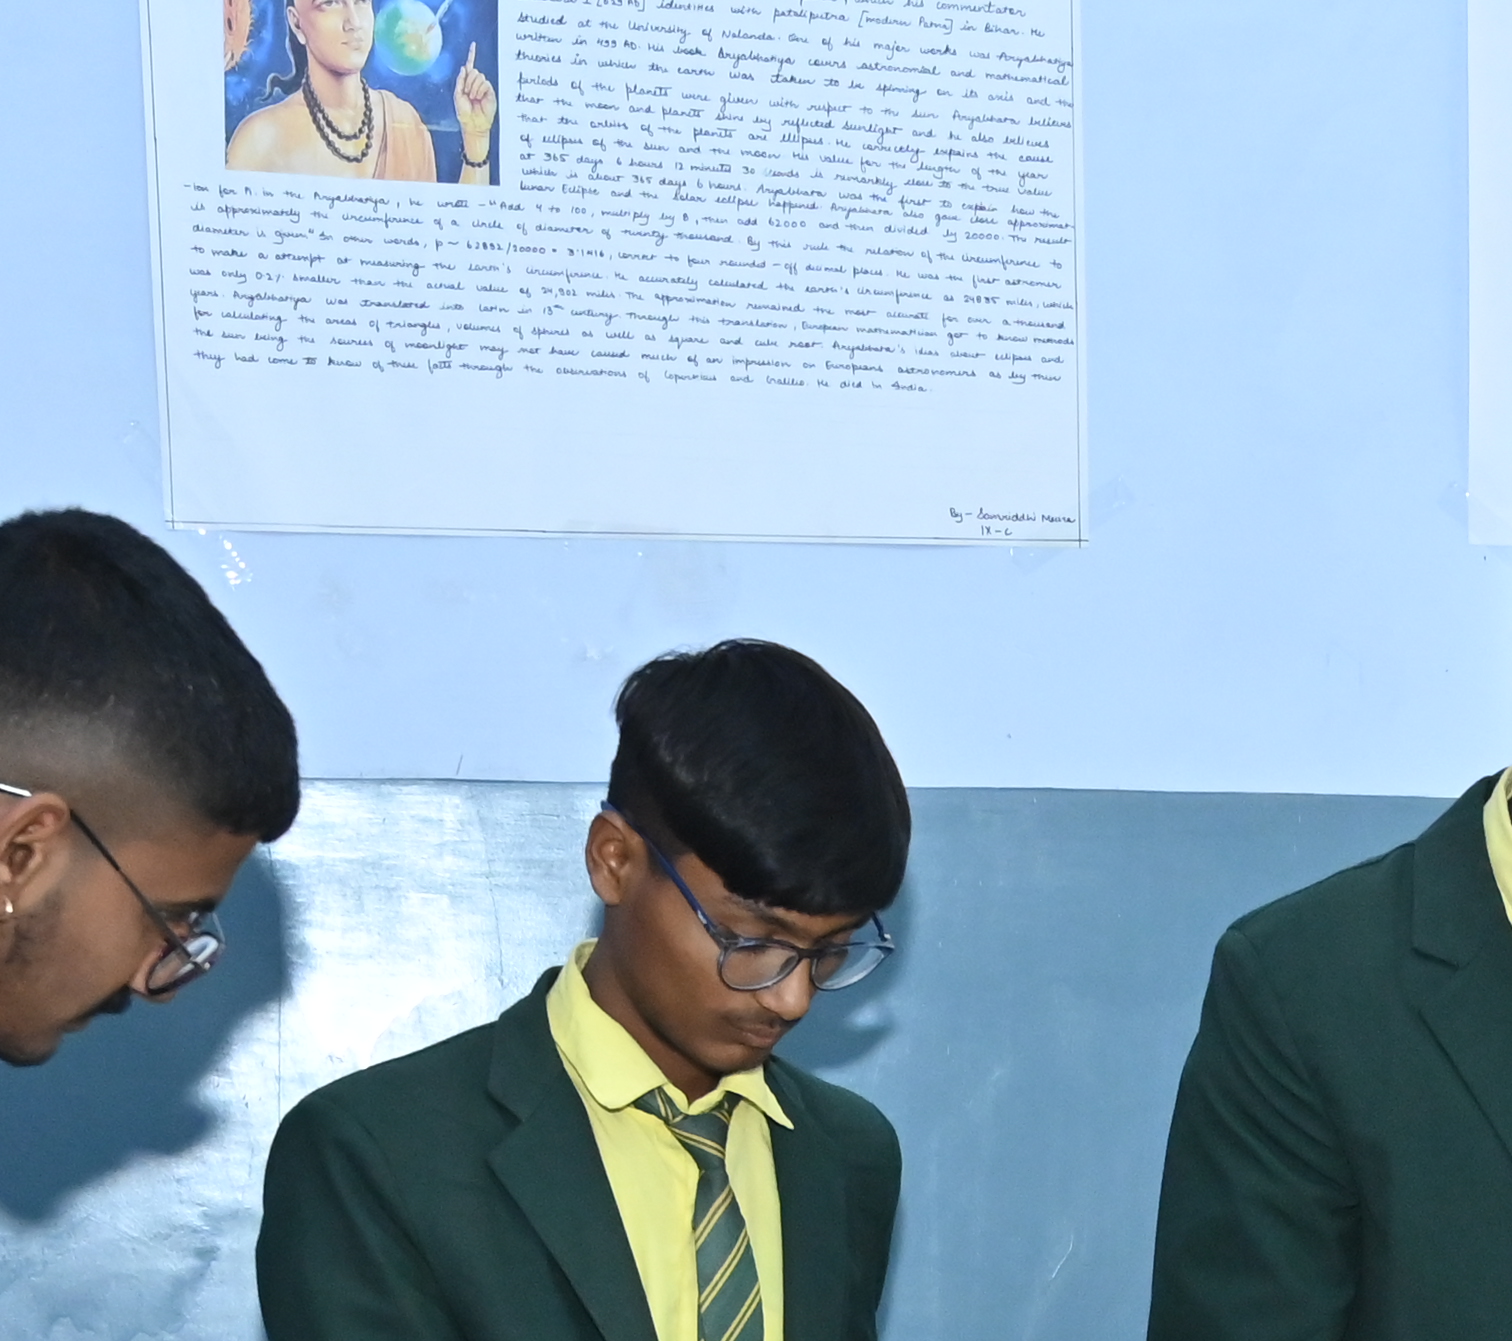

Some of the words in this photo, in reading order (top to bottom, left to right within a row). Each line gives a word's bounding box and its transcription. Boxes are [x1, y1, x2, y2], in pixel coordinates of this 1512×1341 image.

[600, 19, 618, 30] the
[629, 20, 691, 44] University
[702, 28, 713, 42] of
[822, 36, 833, 51] of
[844, 35, 860, 48] his
